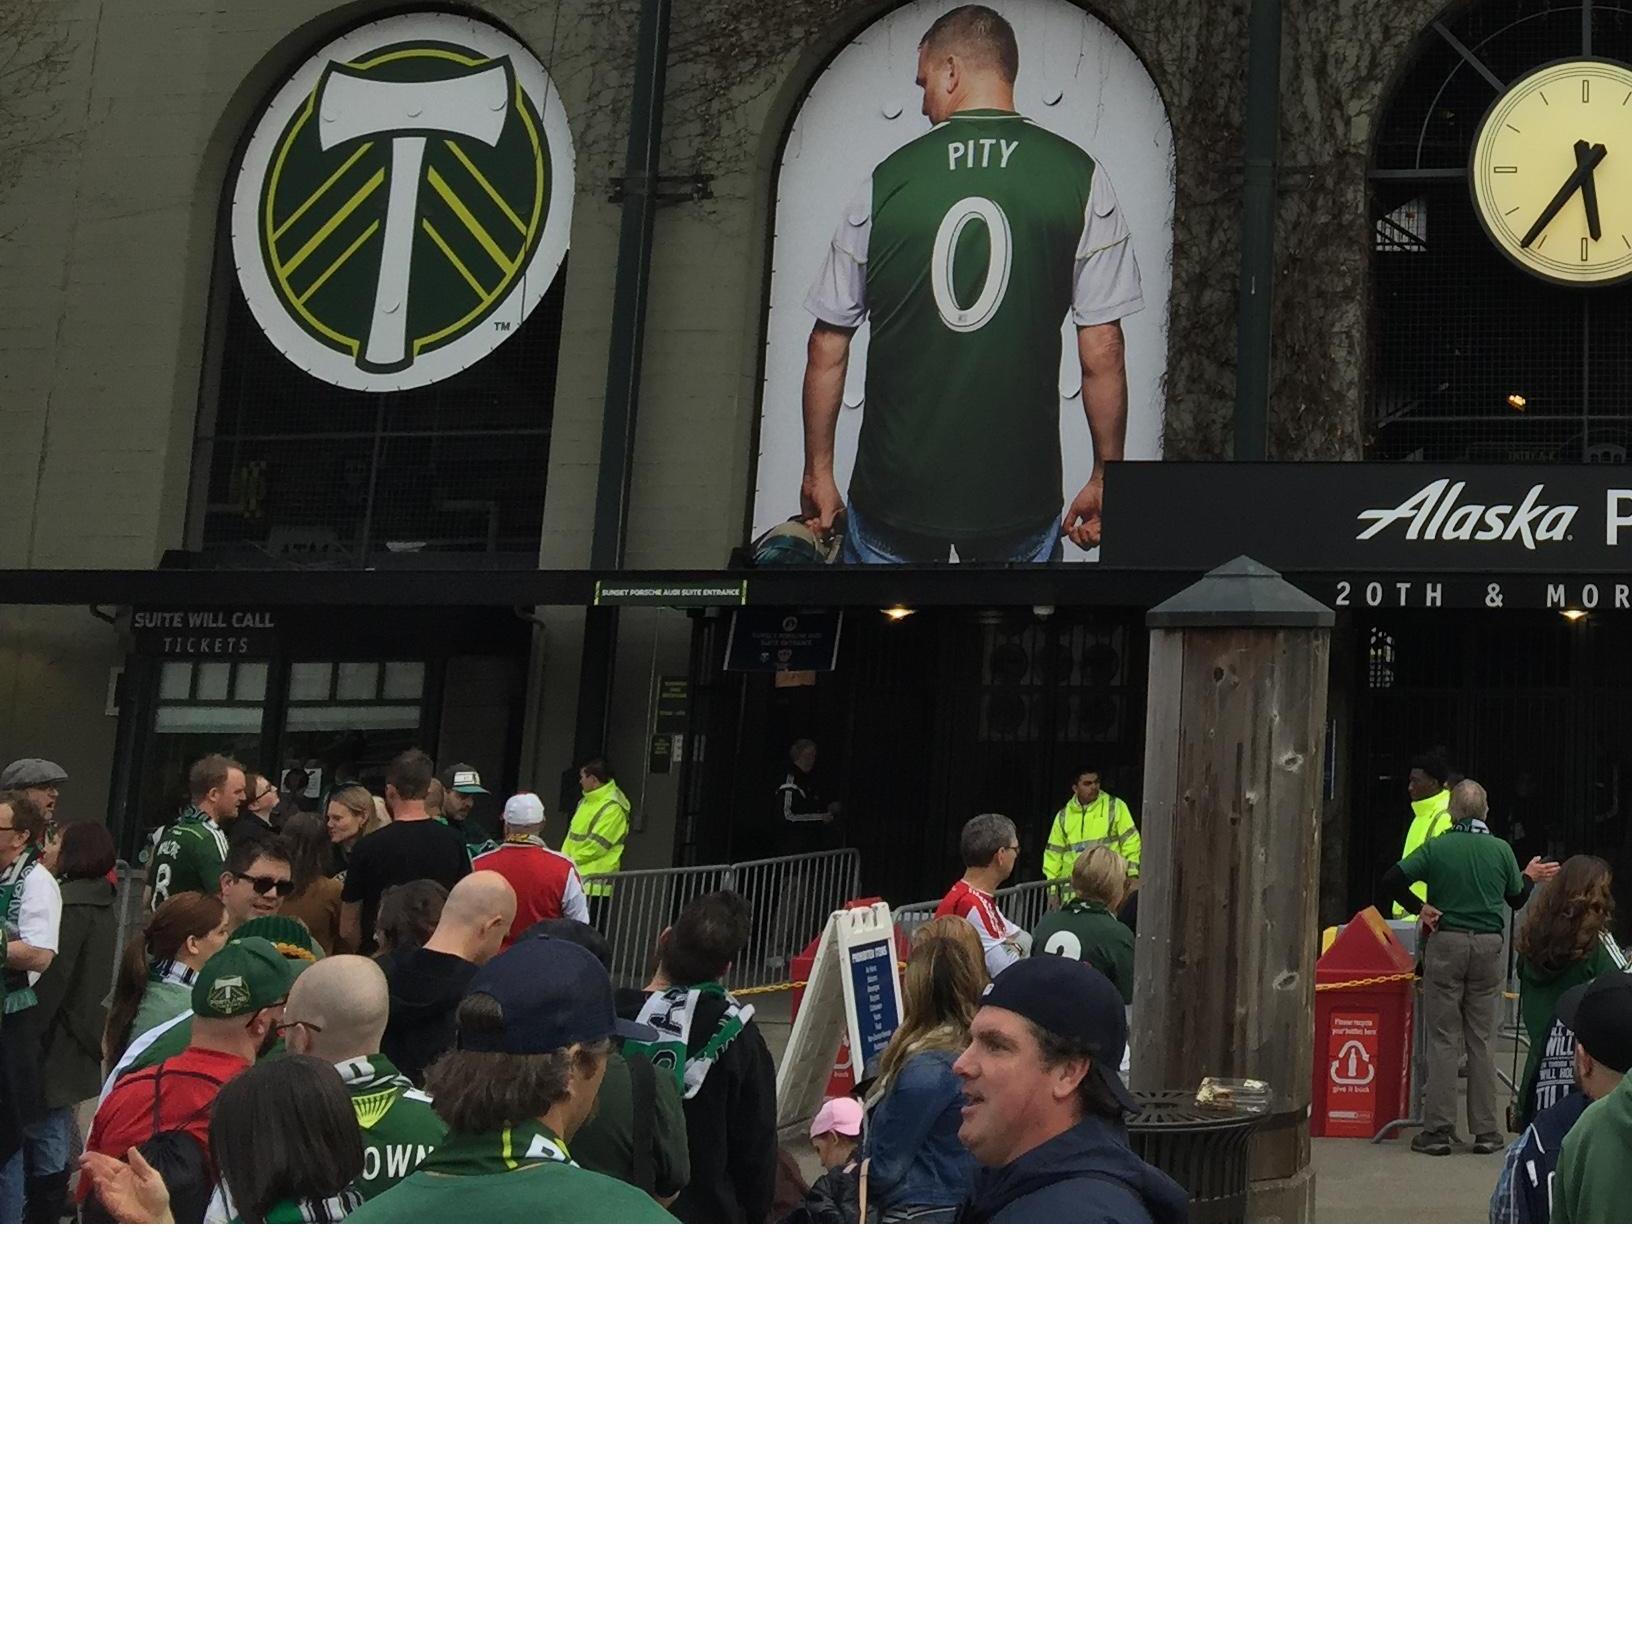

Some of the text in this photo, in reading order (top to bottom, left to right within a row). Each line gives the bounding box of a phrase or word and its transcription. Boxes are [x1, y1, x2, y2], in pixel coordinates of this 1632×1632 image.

[947, 138, 1019, 171] PITY
[931, 196, 1013, 333] 0
[494, 322, 511, 332] TM
[1355, 477, 1579, 551] Alaska
[1336, 582, 1443, 608] 20TH
[1485, 583, 1503, 608] &
[134, 611, 275, 629] SUITE WILL CALL
[163, 636, 249, 654] TICKETS
